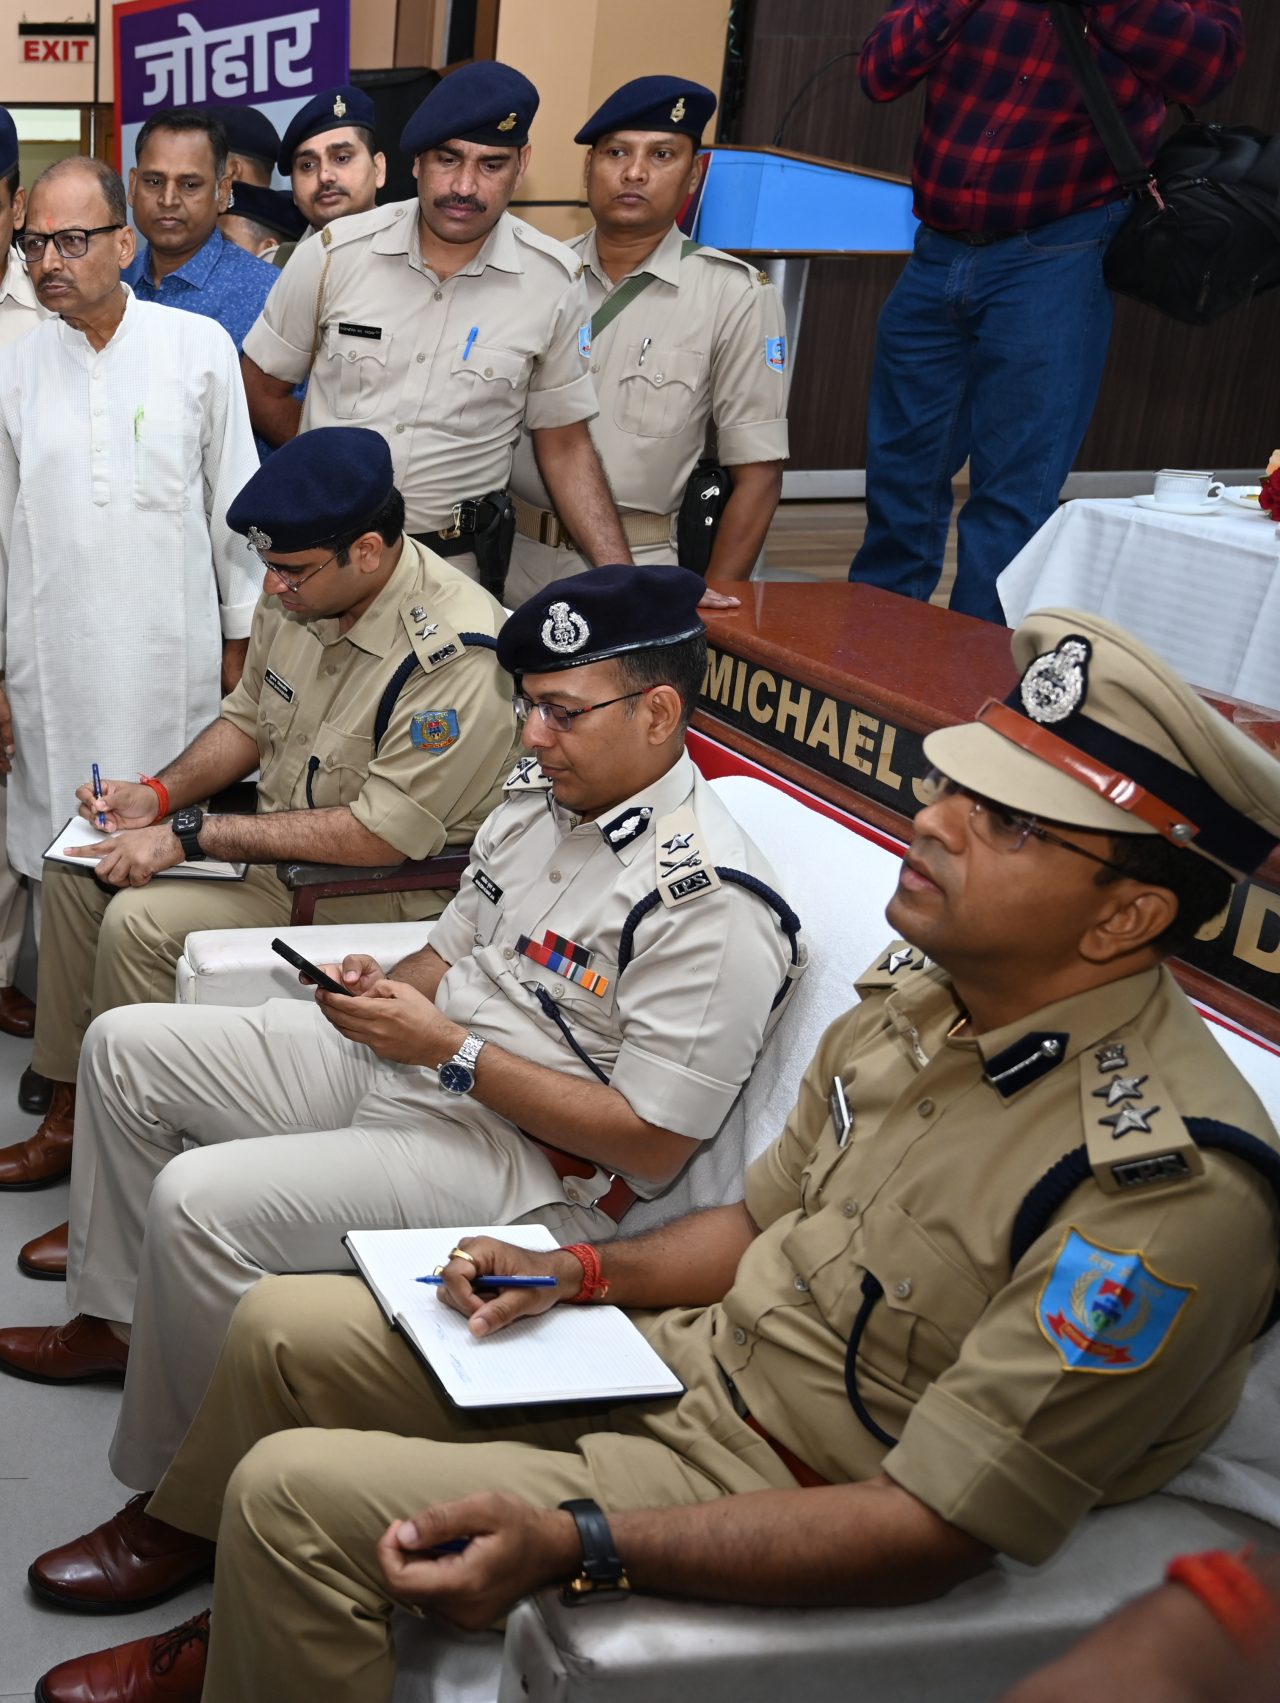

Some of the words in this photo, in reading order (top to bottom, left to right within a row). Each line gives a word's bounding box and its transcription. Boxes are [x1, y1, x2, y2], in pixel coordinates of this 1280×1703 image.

[23, 40, 89, 61] EXIT
[135, 8, 320, 106] जोहार
[699, 648, 902, 790] MICHAEL
